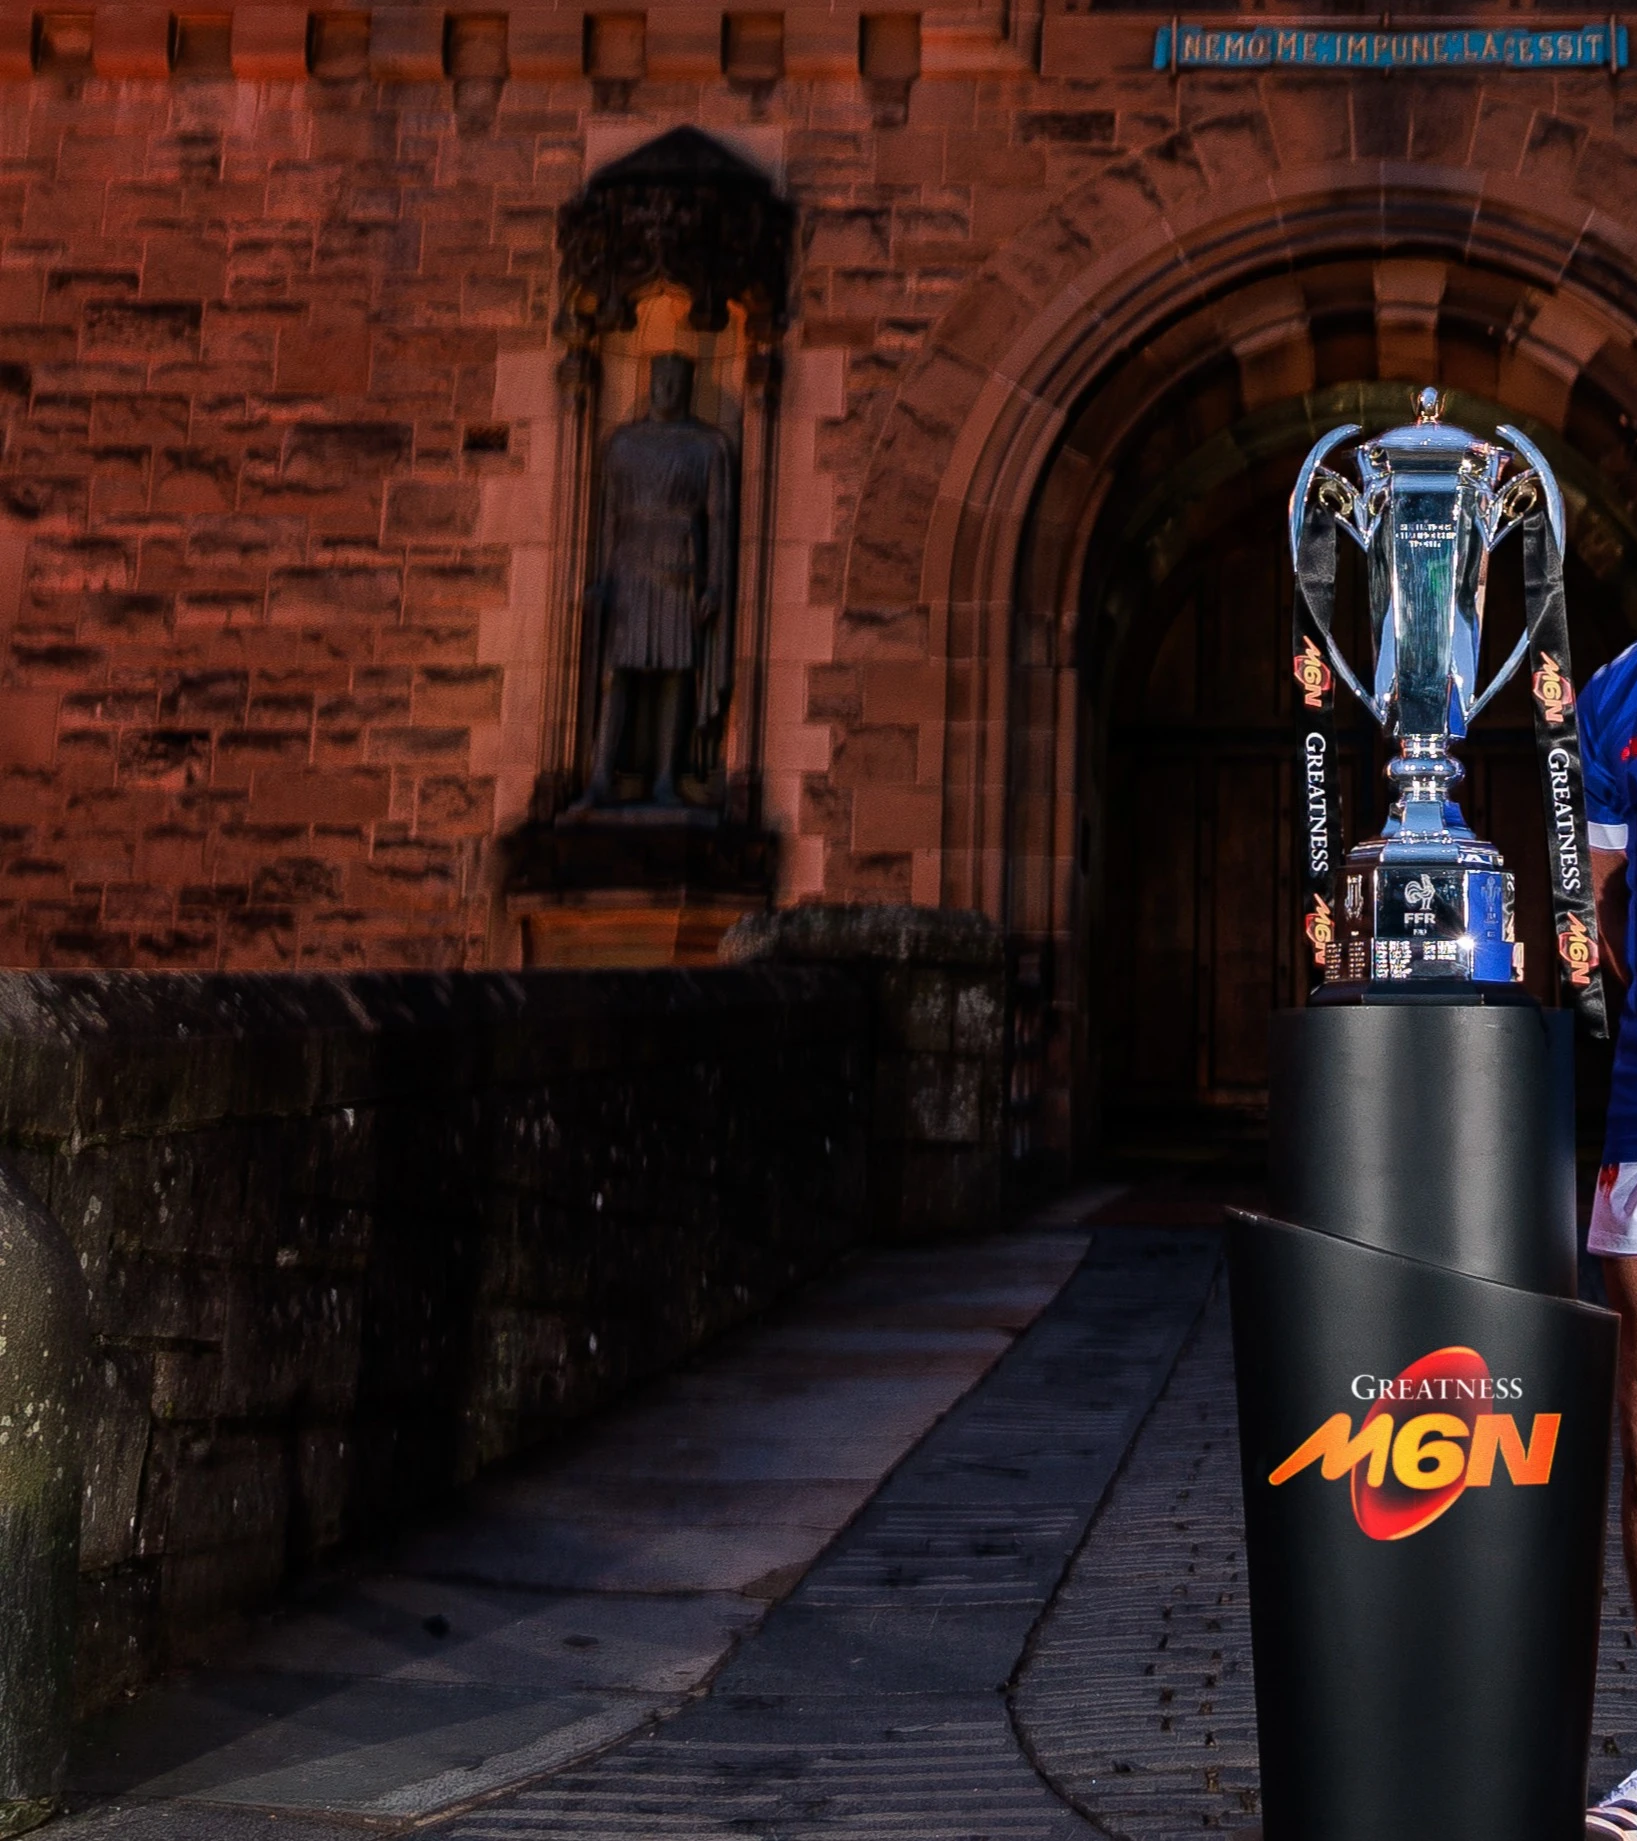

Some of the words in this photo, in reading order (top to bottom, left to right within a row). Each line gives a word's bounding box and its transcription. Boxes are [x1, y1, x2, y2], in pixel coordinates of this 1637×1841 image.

[1184, 33, 1272, 62] NEMO
[1302, 635, 1323, 708] M6N
[1540, 651, 1564, 723] M6N
[1305, 732, 1329, 874] GREATNESS
[1547, 747, 1582, 892] GREATNESS
[1403, 912, 1436, 924] FFR
[1566, 912, 1591, 986] M6N
[1350, 1373, 1524, 1401] GREATNESS
[1268, 1412, 1562, 1490] M6N
